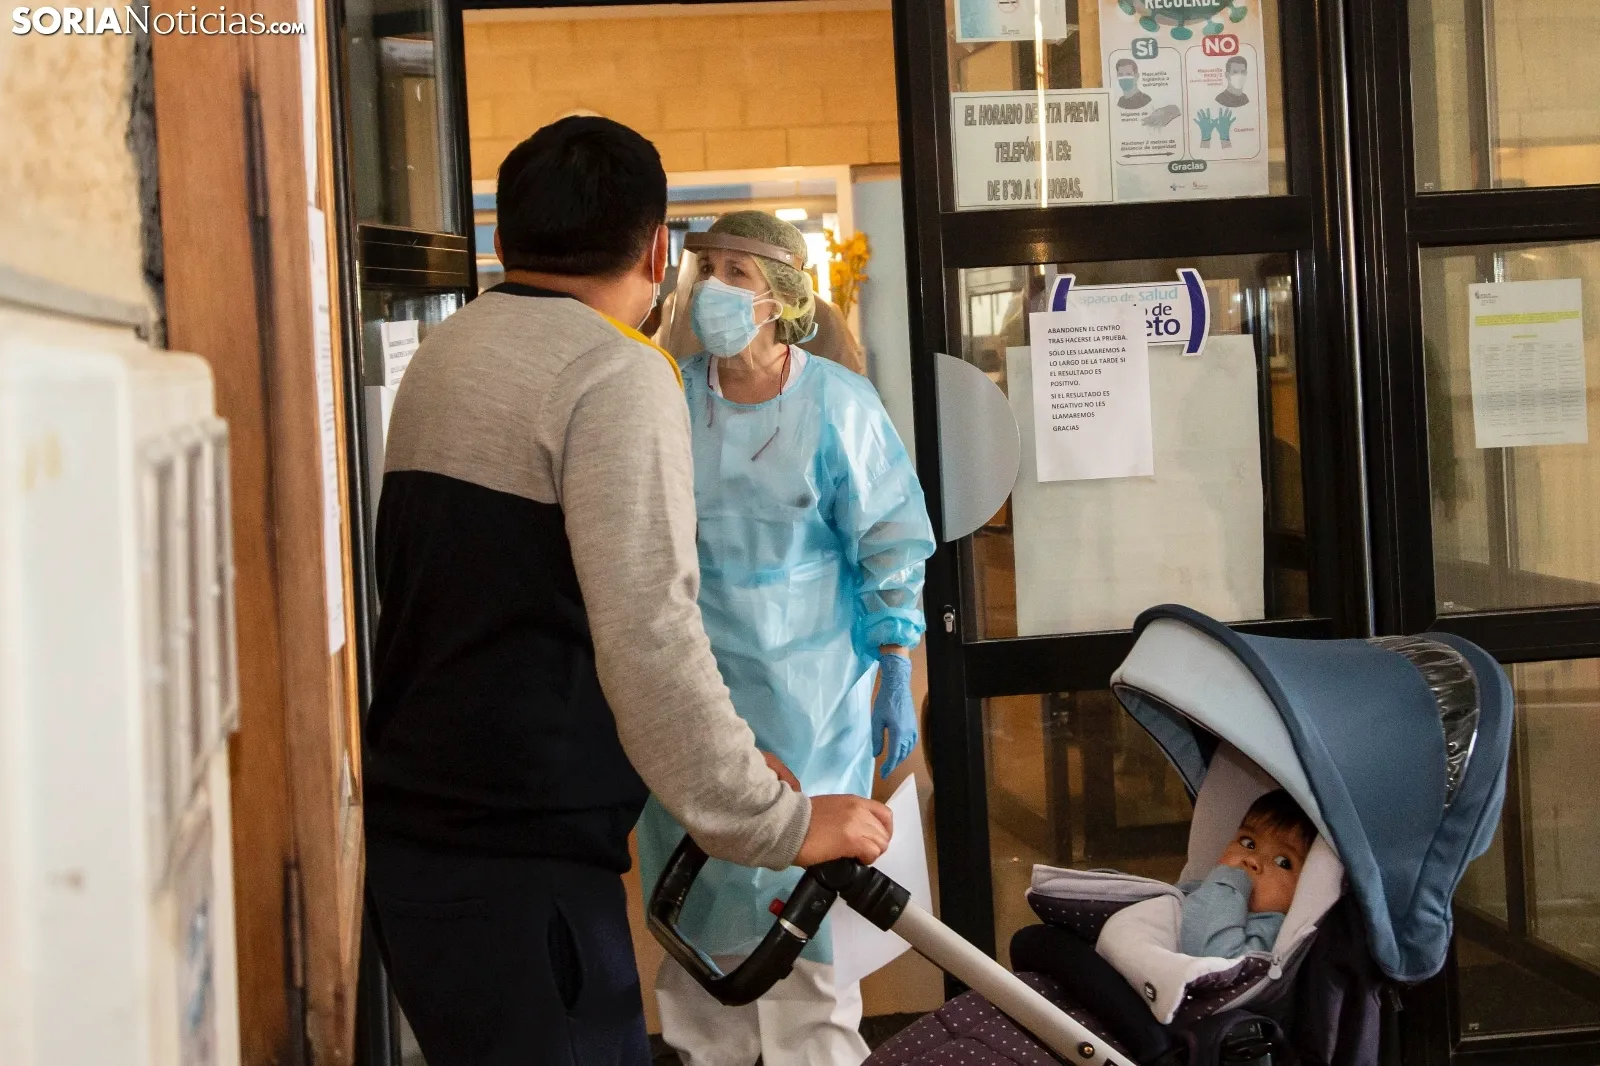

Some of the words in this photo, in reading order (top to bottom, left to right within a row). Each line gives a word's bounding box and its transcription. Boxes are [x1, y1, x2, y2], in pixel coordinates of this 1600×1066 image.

[1135, 39, 1154, 56] Sí
[1205, 37, 1236, 54] NO
[964, 104, 977, 126] EL
[978, 103, 1023, 126] HORARIO
[1024, 102, 1039, 124] DE
[1064, 101, 1100, 123] PREVIA
[1056, 140, 1072, 162] ES:
[1171, 161, 1205, 171] Gracias
[987, 180, 1000, 202] DE
[1024, 178, 1032, 200] A
[1047, 177, 1084, 199] HORAS.
[1138, 286, 1178, 303] salud
[1151, 302, 1173, 316] de
[1047, 326, 1088, 334] ABANDONEN
[1096, 324, 1121, 332] CENTRO
[1101, 334, 1128, 342] PRUEBA.
[1077, 347, 1120, 355] LLAMAREMOS
[1052, 411, 1096, 420] LLAMAREMOS
[1052, 424, 1080, 432] GRACIAS
